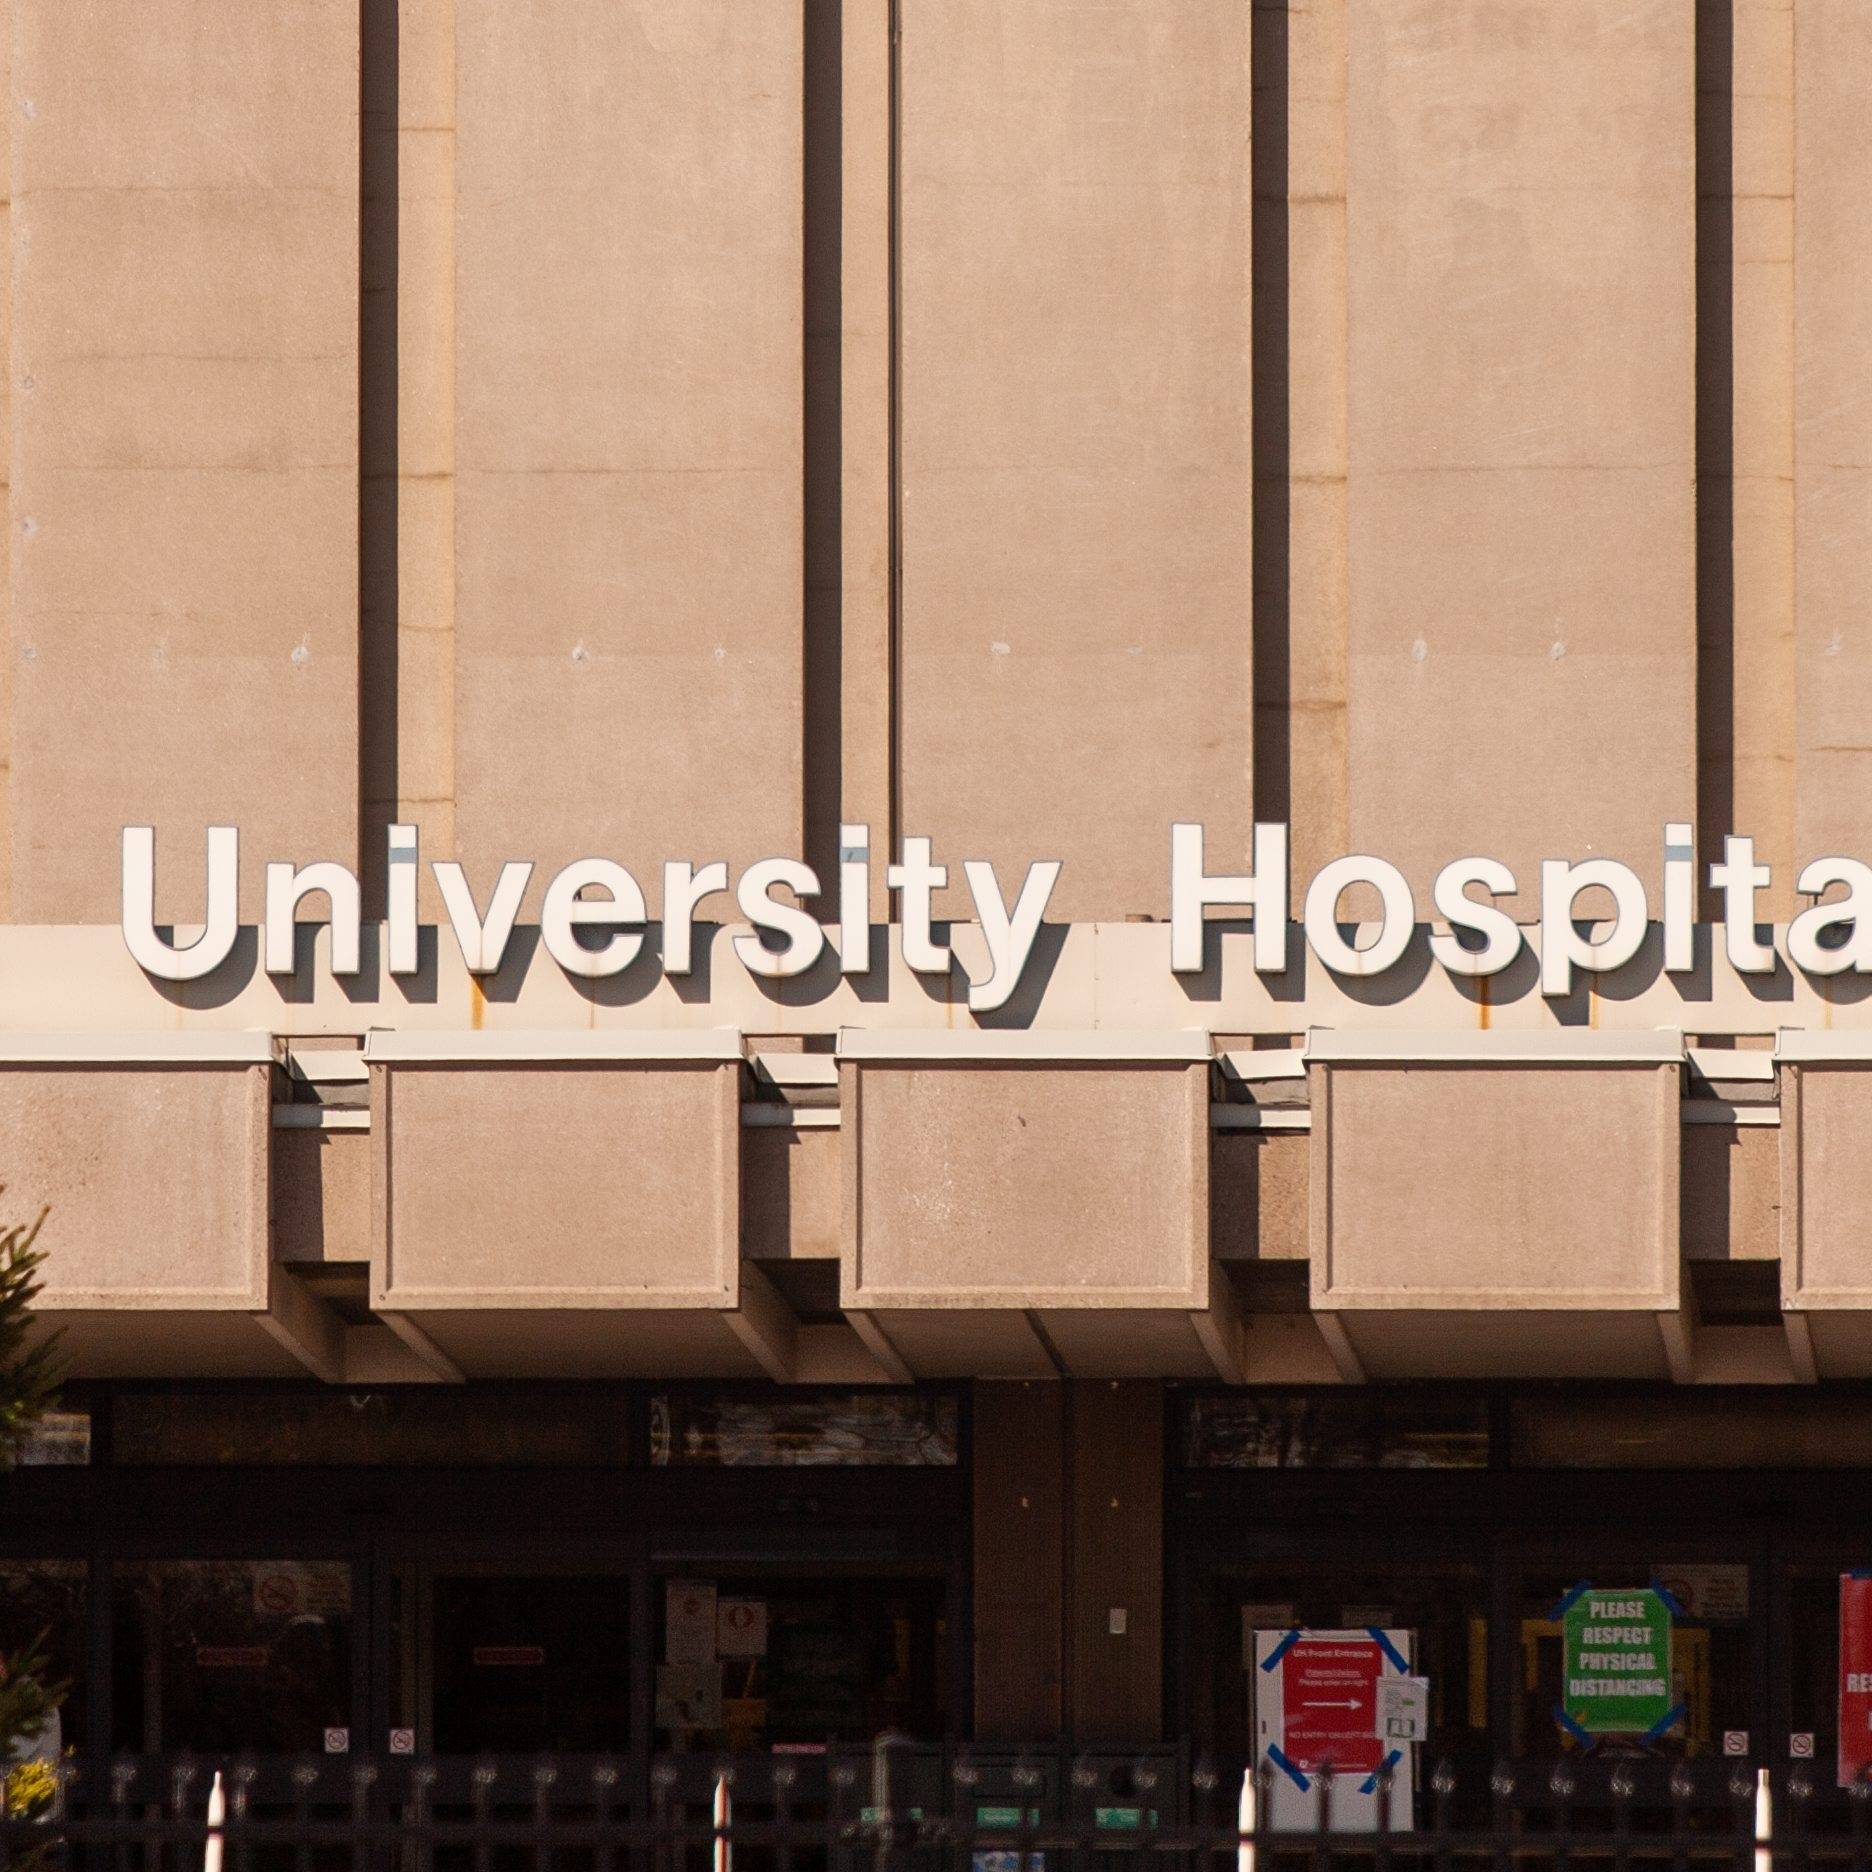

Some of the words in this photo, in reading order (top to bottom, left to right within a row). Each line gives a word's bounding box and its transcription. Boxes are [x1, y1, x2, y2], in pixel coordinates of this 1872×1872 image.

[121, 823, 1063, 1012] University
[1589, 1601, 1646, 1619] PLEASE
[1582, 1627, 1653, 1645] RESPECT
[1334, 1649, 1374, 1658] Entrance
[1579, 1652, 1658, 1671] PHYSICAL
[1569, 1679, 1667, 1697] DISTANCING
